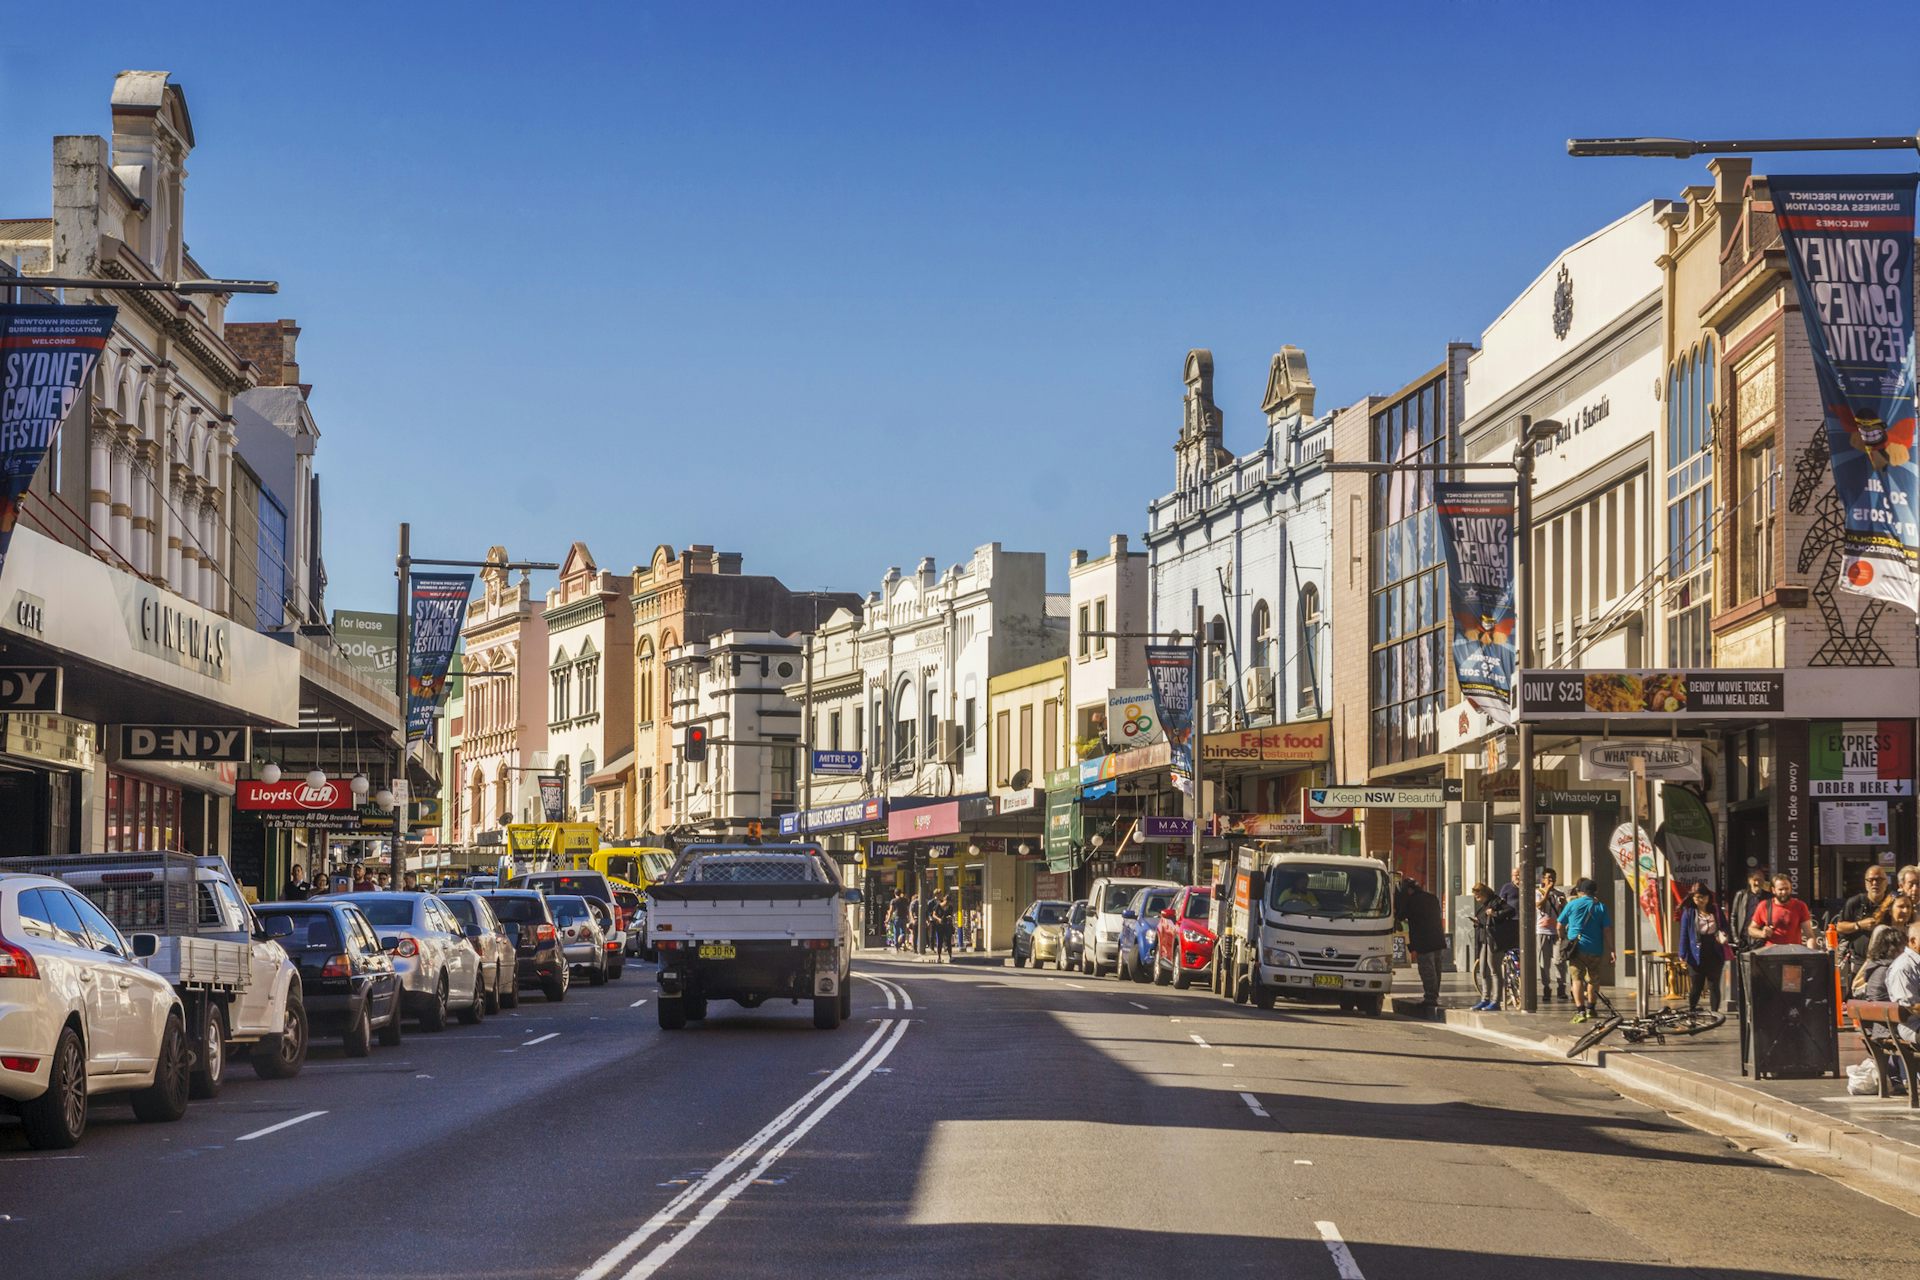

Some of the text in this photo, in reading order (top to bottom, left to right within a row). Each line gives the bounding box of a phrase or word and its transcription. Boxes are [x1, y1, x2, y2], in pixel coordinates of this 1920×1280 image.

[4, 352, 96, 388] SYDNEY
[416, 600, 462, 620] SYDNEY
[340, 617, 382, 630] for lease
[414, 618, 458, 637] COMEDY
[141, 598, 224, 668] CINEMAS
[341, 641, 376, 659] pole
[1524, 682, 1554, 702] ONLY
[1559, 680, 1583, 702] $25
[1690, 681, 1716, 692] DENDY
[1718, 681, 1742, 692] MOVIE
[1743, 681, 1770, 692] TICKET
[1702, 694, 1769, 705] MAIN MEAL DEAL
[130, 728, 240, 756] DENDY
[1240, 734, 1323, 748] Fast food
[1829, 735, 1892, 752] EXPRESS
[819, 754, 845, 763] MITRE
[1262, 750, 1314, 758] restaurant
[1655, 751, 1680, 762] LANE
[1842, 751, 1878, 768] LANE
[1789, 762, 1799, 792] away
[1817, 782, 1888, 794] ORDER HERE
[250, 789, 292, 804] Lloyds
[1332, 792, 1444, 804] Keep NSW Beautifu
[1554, 792, 1617, 804] Whateley La
[1788, 796, 1798, 822] Take
[316, 813, 328, 822] Day
[1788, 832, 1798, 842] In
[1788, 844, 1798, 862] Eat
